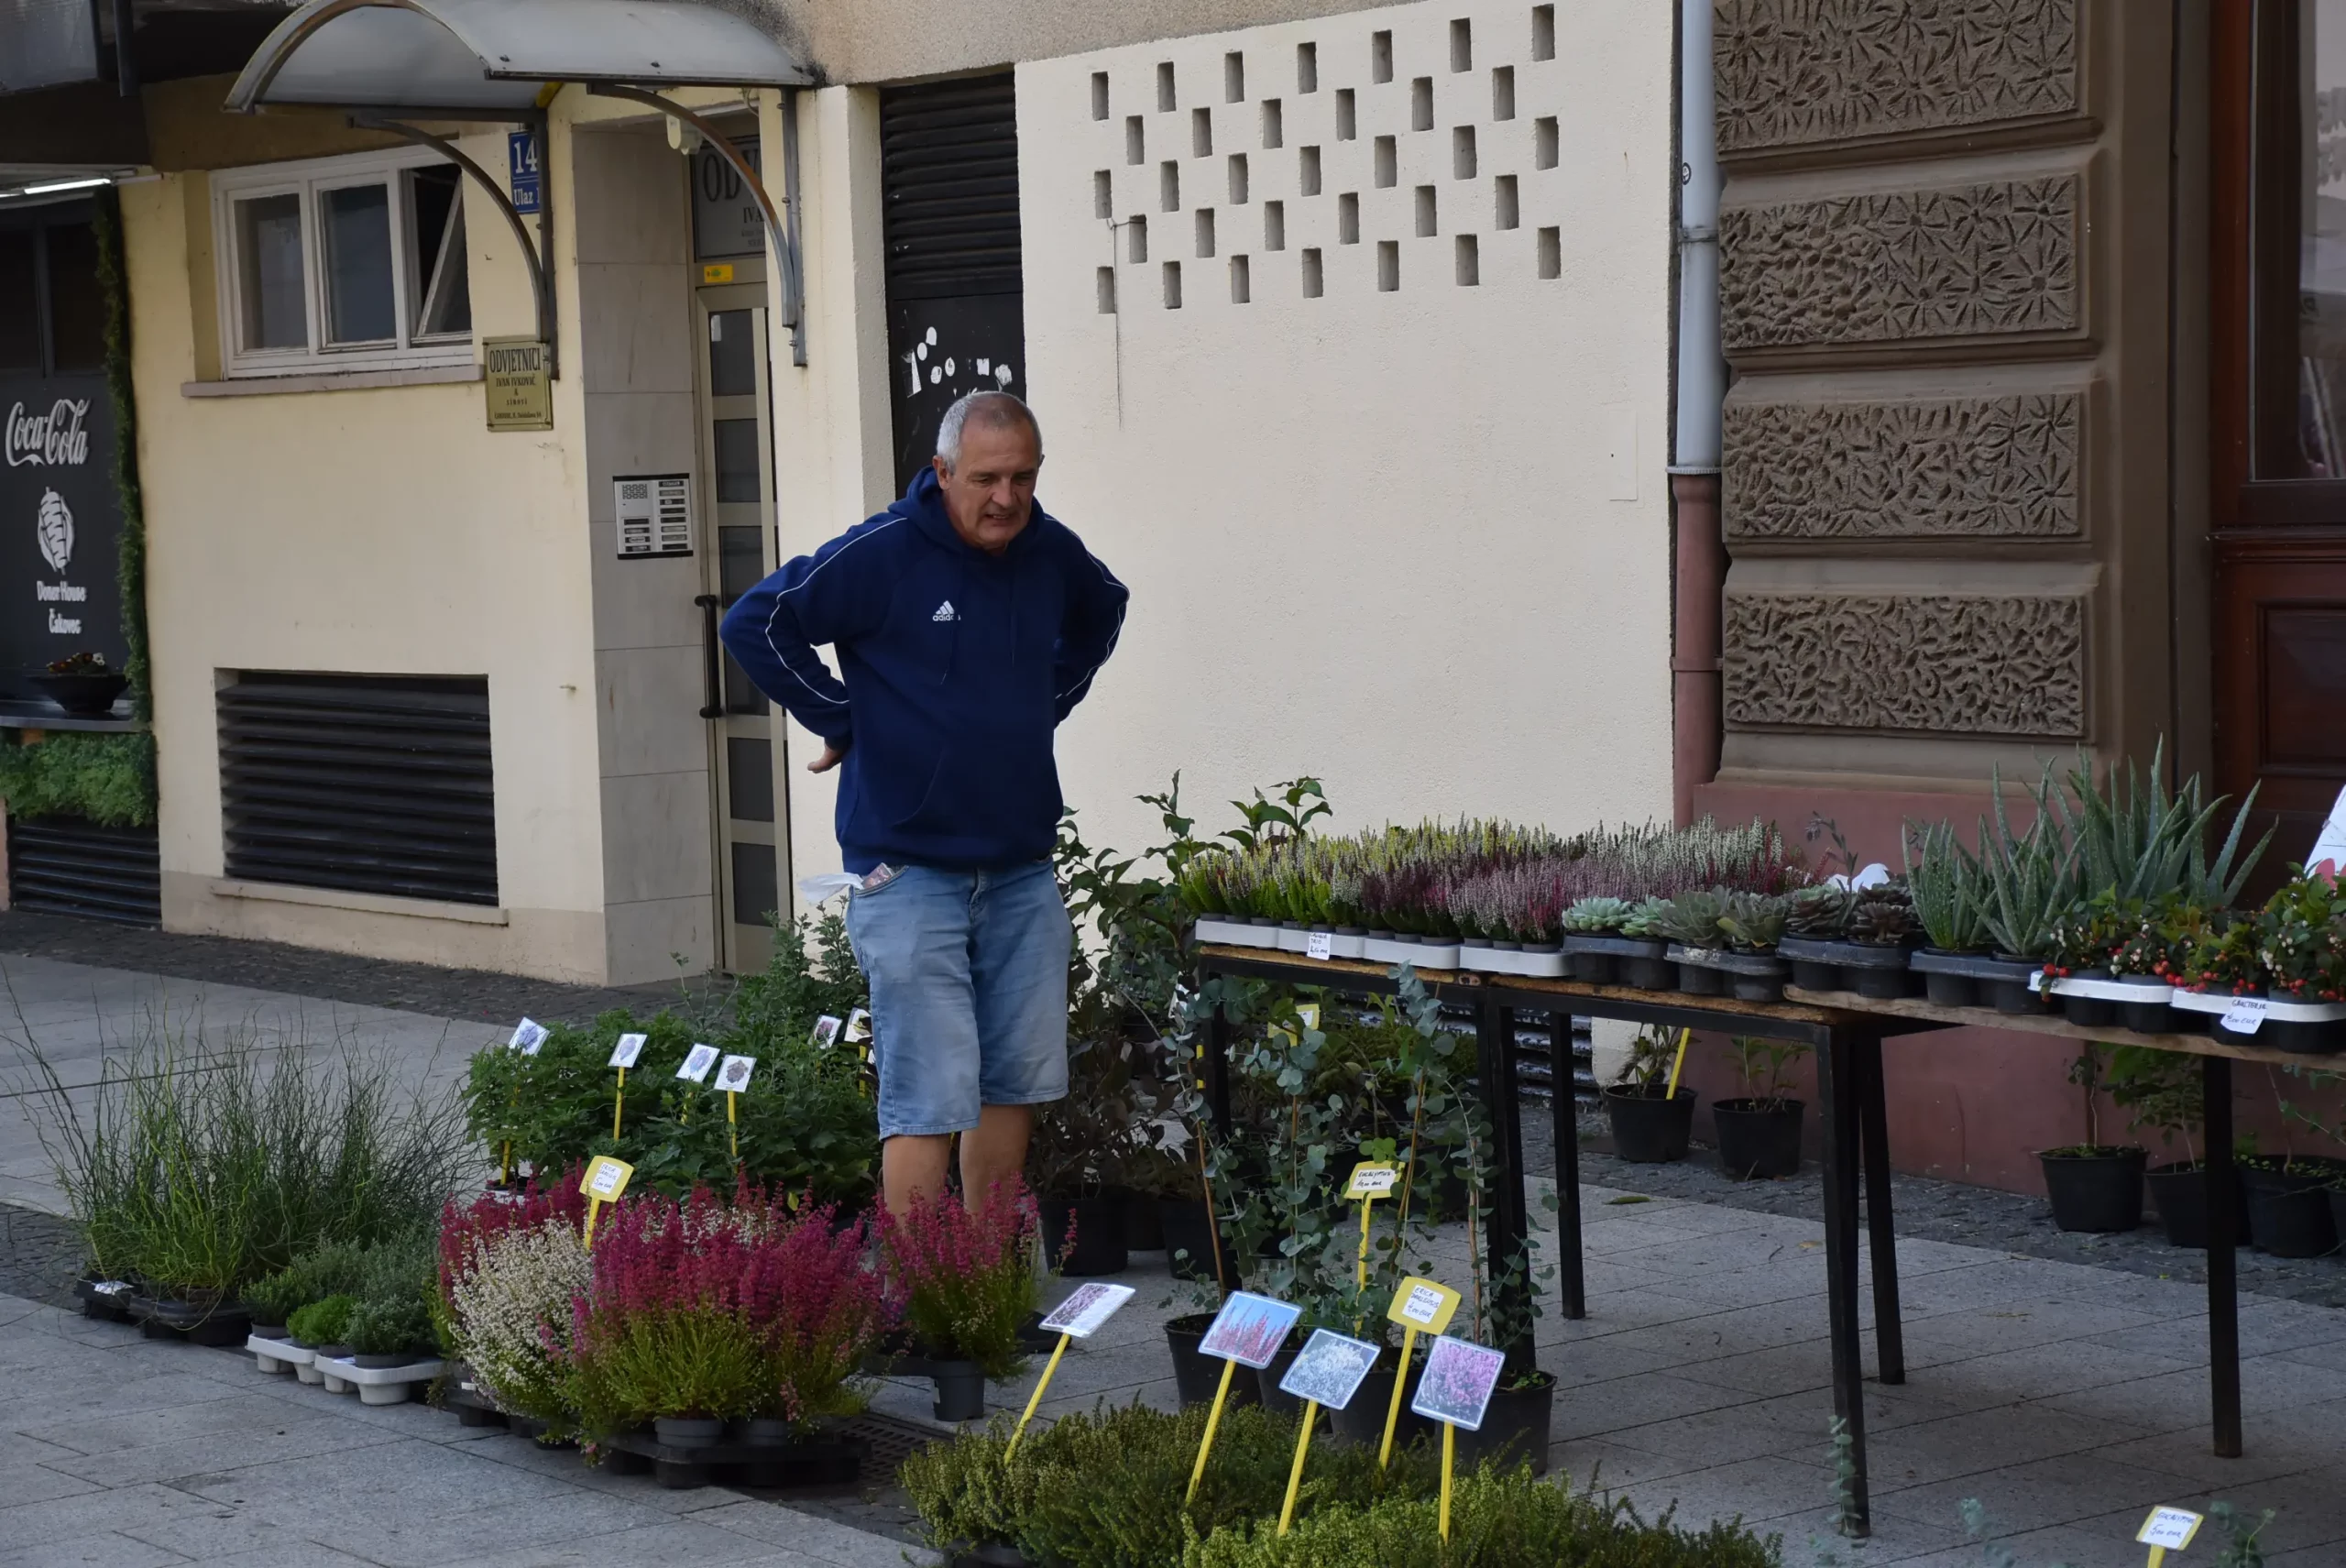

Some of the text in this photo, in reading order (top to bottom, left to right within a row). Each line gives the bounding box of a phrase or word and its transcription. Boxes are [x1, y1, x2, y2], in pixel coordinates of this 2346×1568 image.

[514, 137, 539, 174] 14
[513, 187, 534, 206] Ulaz
[489, 348, 541, 375] ODVJETNICI
[5, 397, 93, 466] Coca-Cola
[60, 580, 87, 602] House
[1414, 1287, 1435, 1299] ERICA
